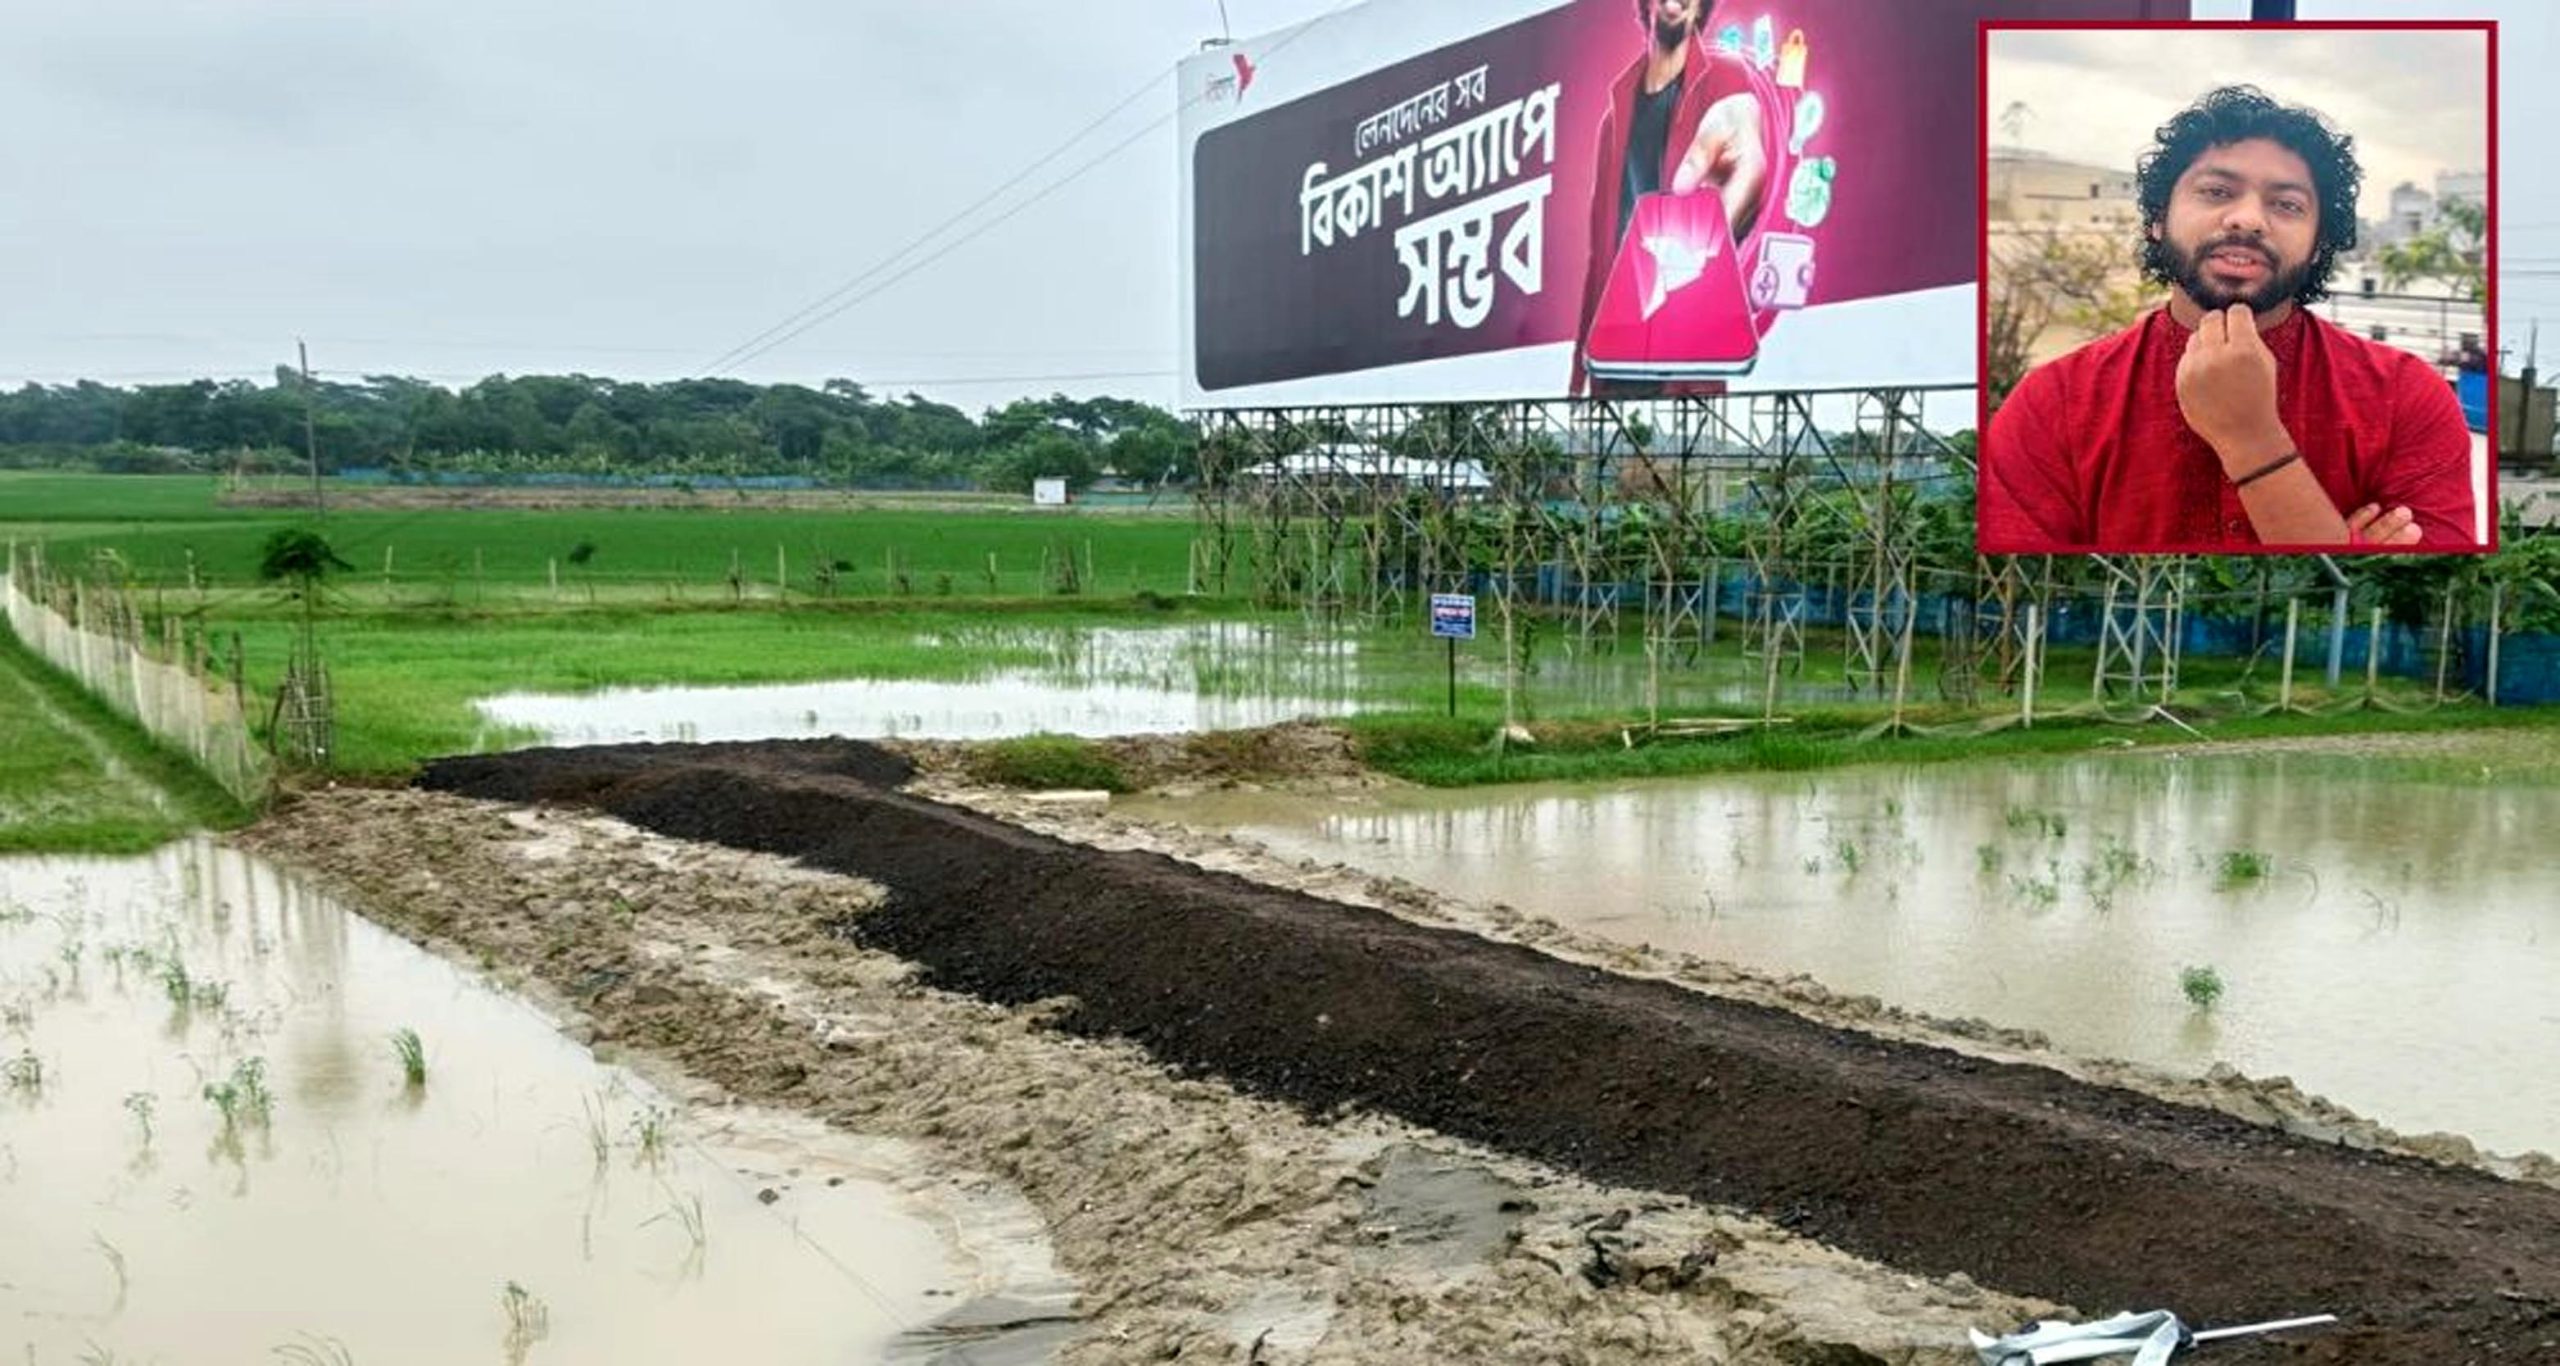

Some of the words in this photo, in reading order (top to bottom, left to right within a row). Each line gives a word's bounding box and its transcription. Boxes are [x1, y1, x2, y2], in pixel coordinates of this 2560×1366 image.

[1300, 142, 1418, 255] বিকাশ
[1421, 81, 1560, 198] অ্যাপে
[1354, 81, 1450, 157] লেনদেনের
[1454, 64, 1488, 108] সব
[1395, 173, 1552, 328] সম্ভব
